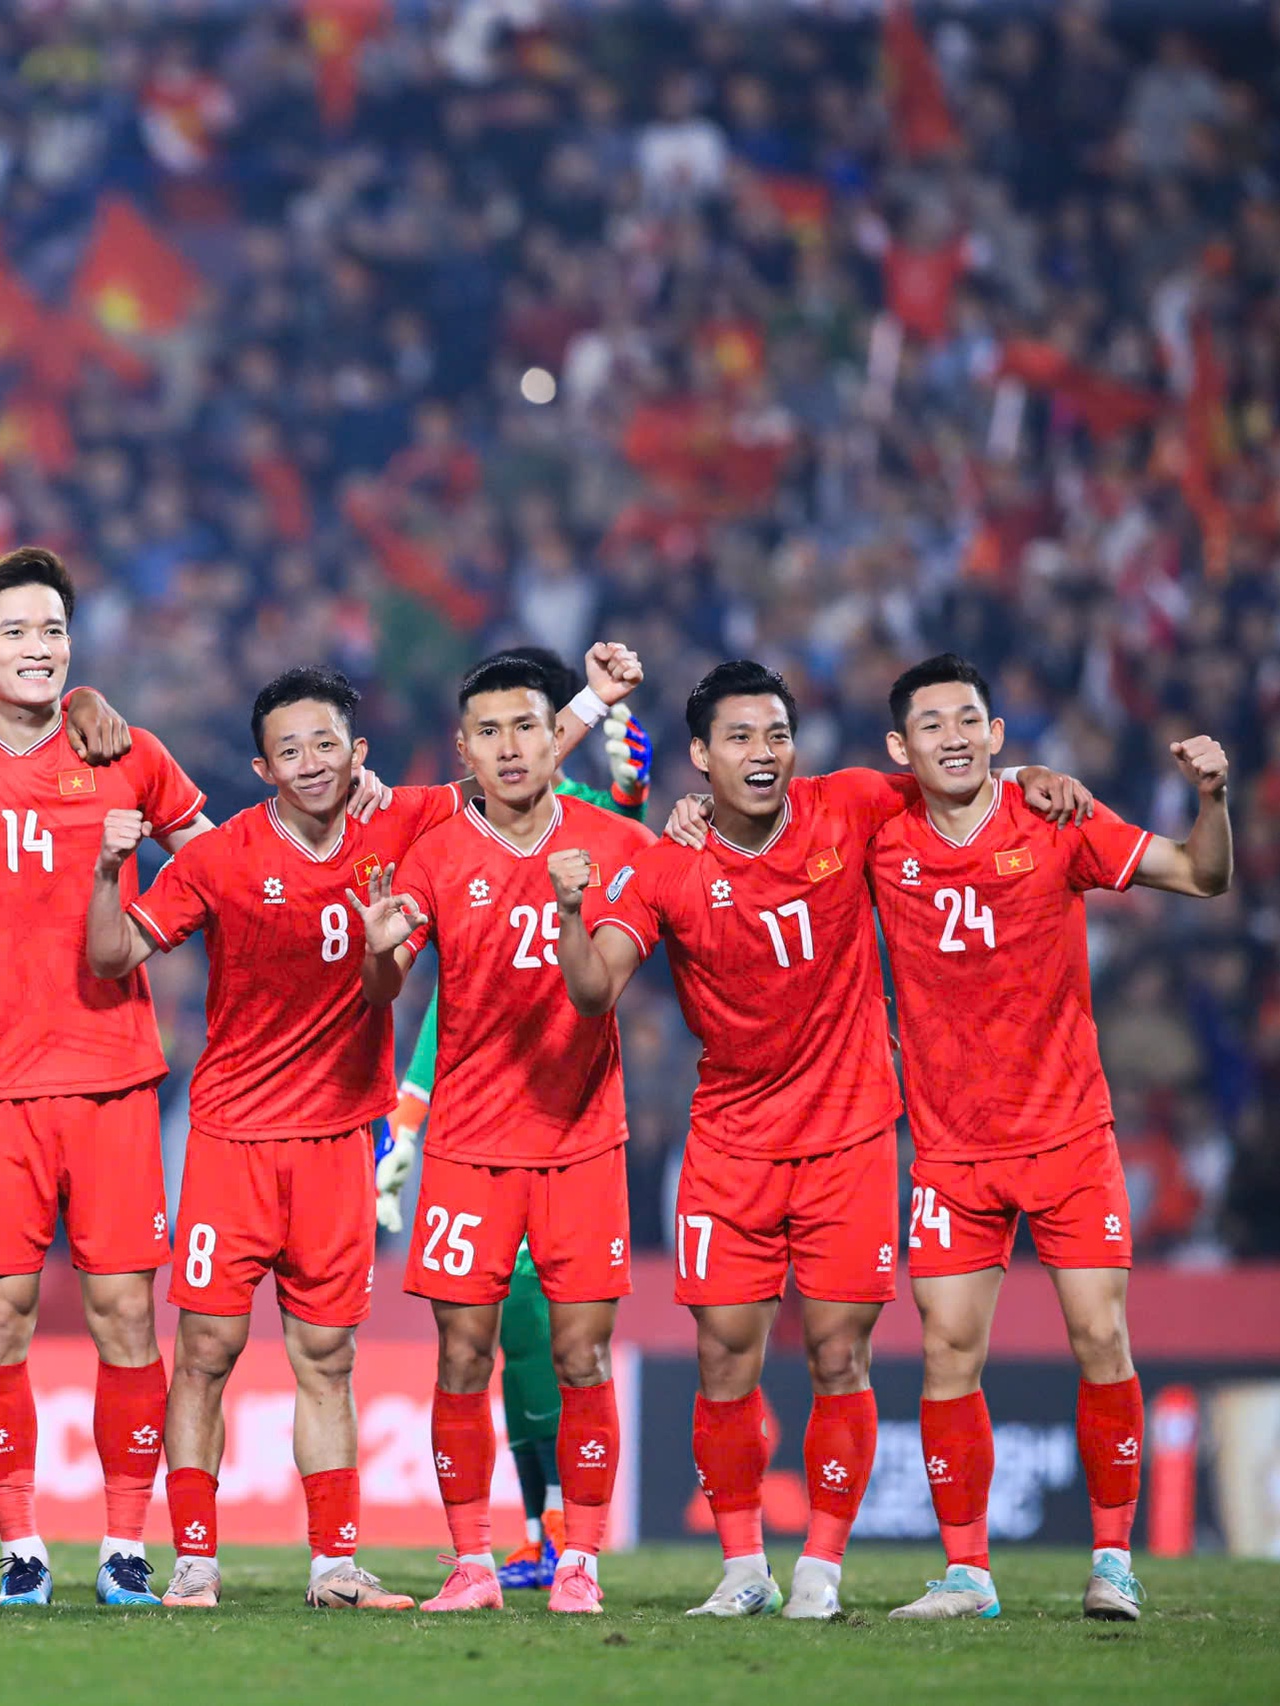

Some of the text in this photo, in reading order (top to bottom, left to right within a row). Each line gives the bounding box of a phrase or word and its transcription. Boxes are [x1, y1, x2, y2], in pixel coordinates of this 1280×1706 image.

[1, 809, 53, 873] 14
[320, 903, 349, 963] 8
[509, 901, 561, 969] 25
[758, 899, 814, 968] 17
[934, 886, 996, 952] 24
[422, 1205, 482, 1276] 25
[678, 1214, 713, 1280] 17
[909, 1186, 951, 1249] 24
[185, 1222, 216, 1288] 8
